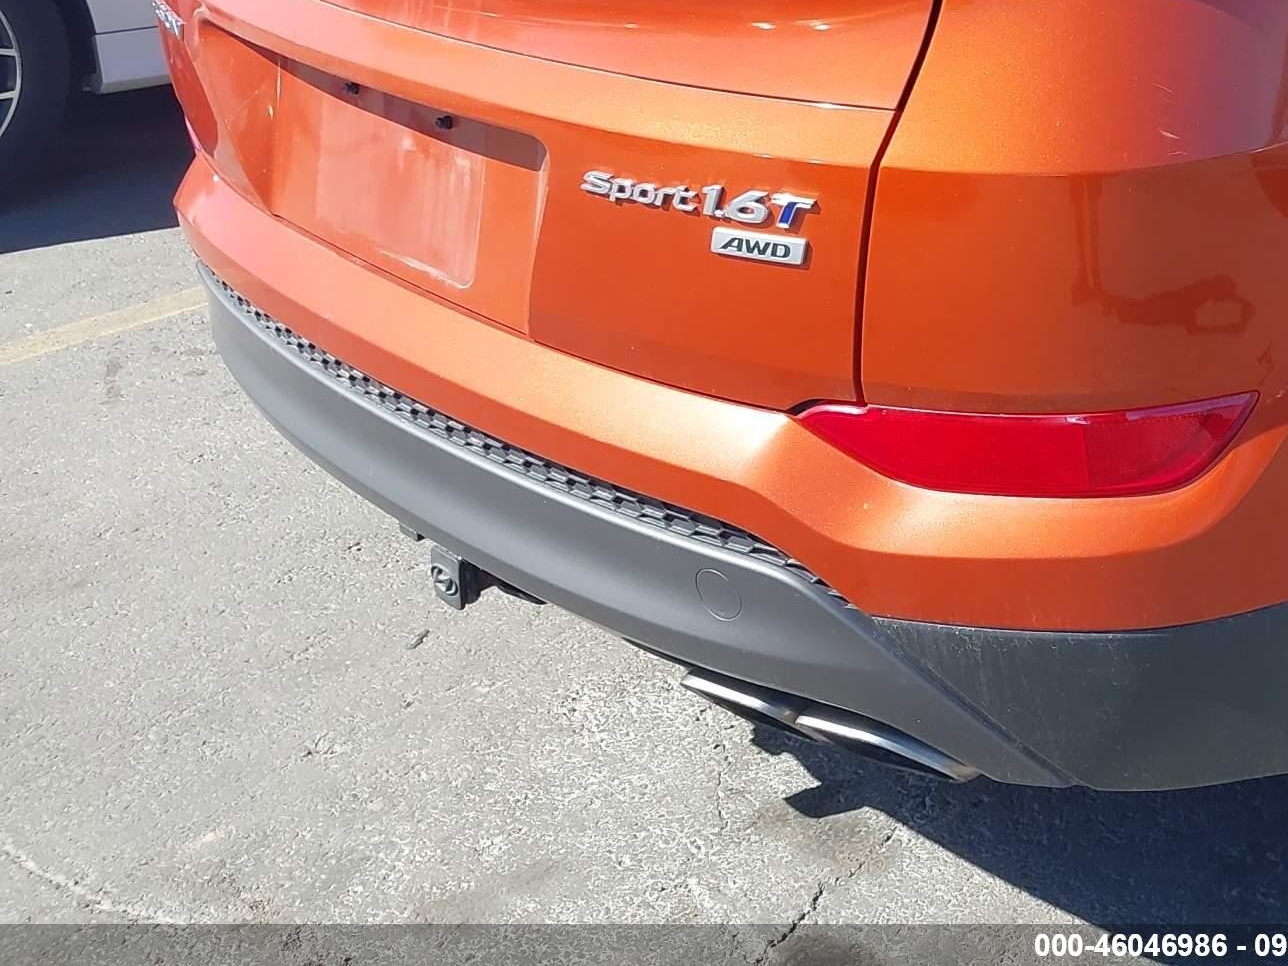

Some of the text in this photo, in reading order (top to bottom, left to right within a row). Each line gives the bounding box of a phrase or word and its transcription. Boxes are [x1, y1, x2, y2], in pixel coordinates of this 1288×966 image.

[580, 170, 818, 229] Sport 1.6T
[719, 236, 792, 259] AWD
